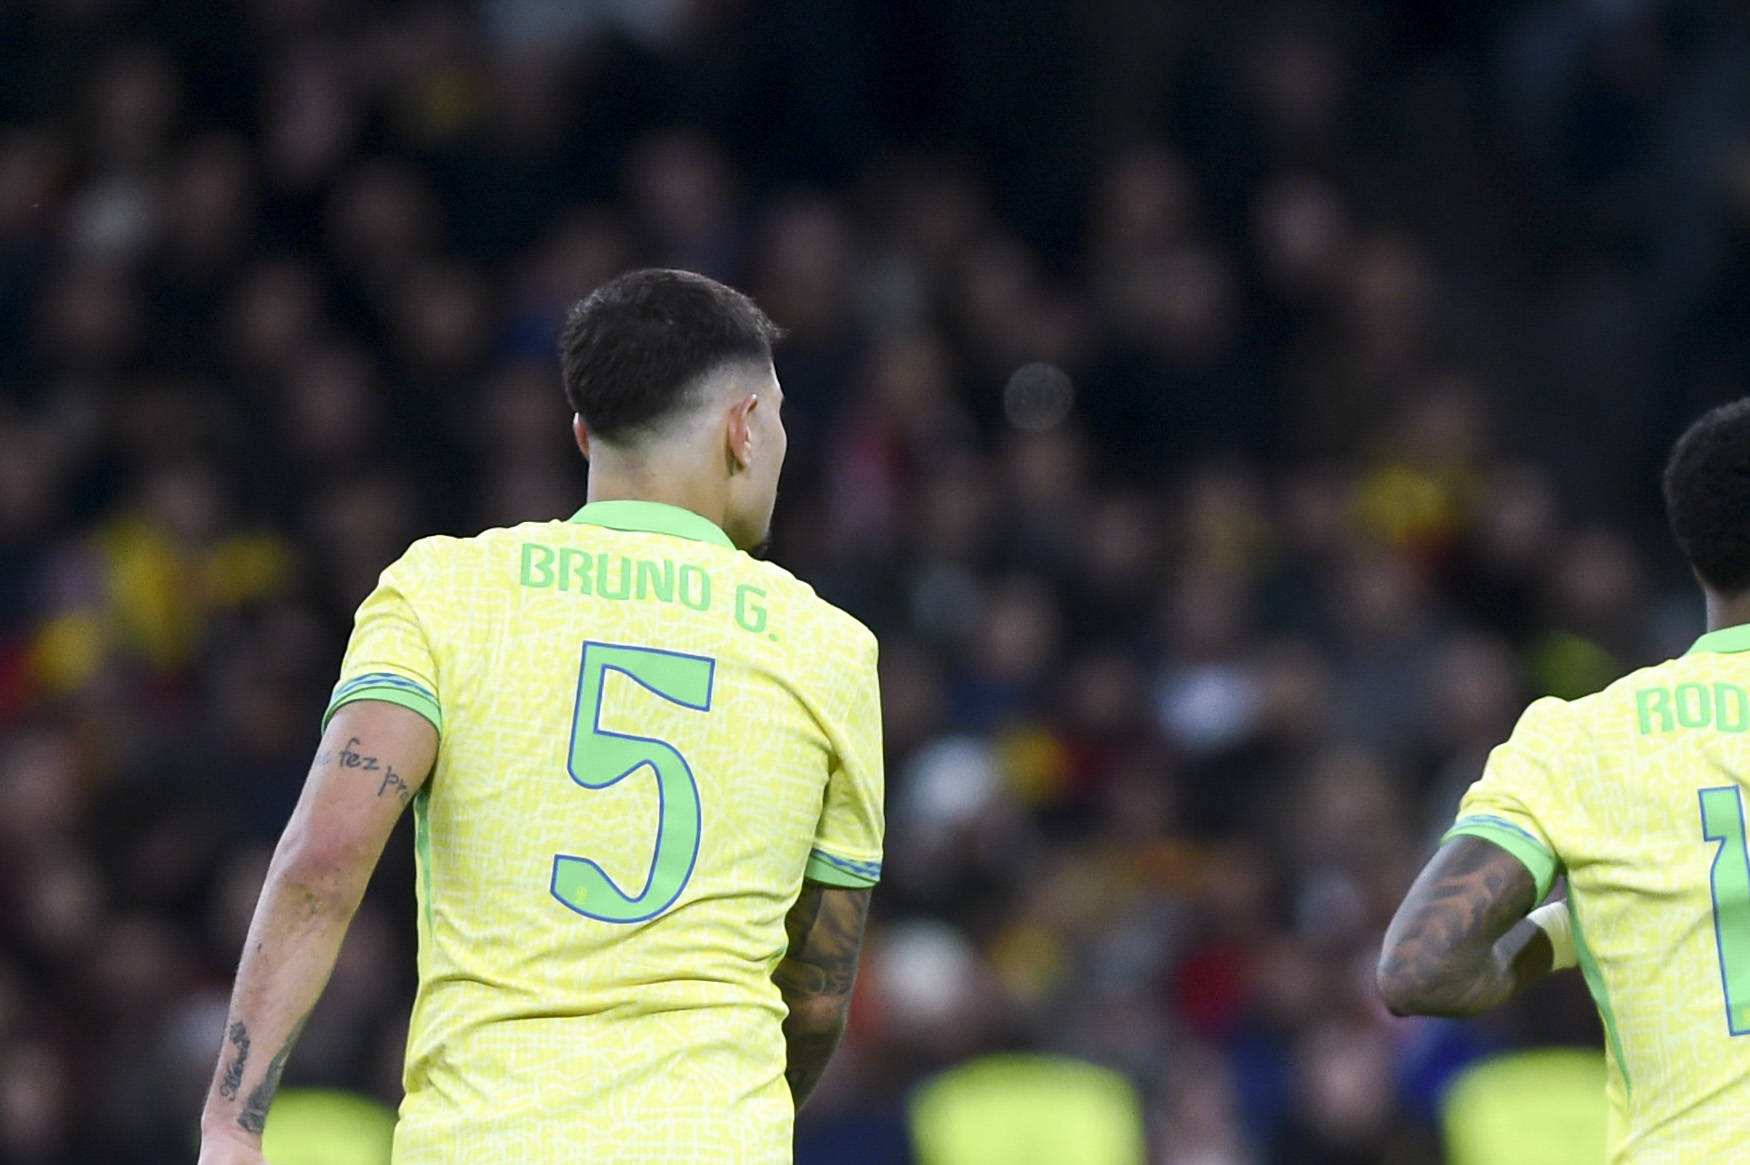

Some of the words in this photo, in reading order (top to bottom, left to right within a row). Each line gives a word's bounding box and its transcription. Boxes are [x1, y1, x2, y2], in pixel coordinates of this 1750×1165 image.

[520, 543, 711, 612] BRUNO
[736, 584, 779, 642] G.
[550, 640, 716, 924] 5
